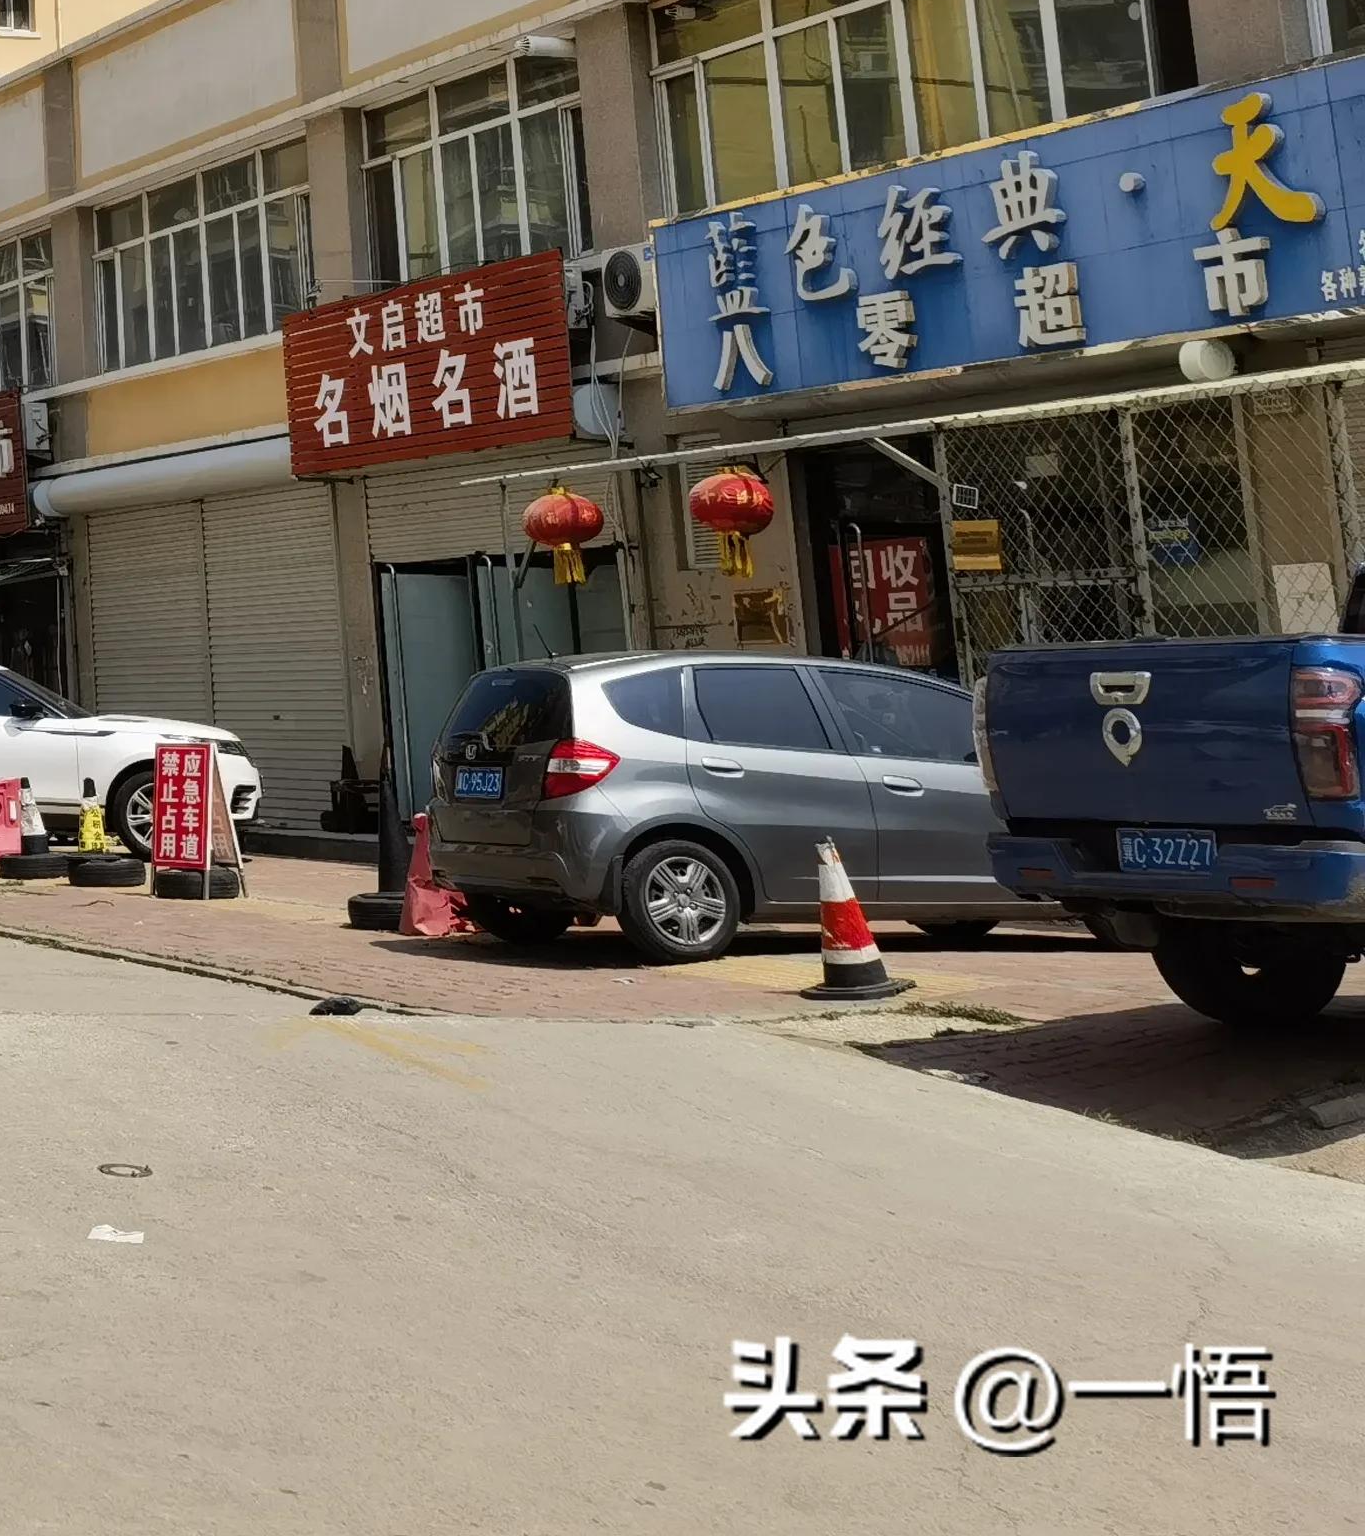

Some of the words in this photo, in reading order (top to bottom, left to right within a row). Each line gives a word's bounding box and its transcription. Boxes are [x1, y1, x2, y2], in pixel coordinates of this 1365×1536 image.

[346, 282, 485, 359] 文启超市
[713, 227, 1270, 391] 八零超市
[314, 336, 539, 448] 名烟名酒
[159, 751, 181, 859] 禁止占用
[180, 751, 202, 860] 应急车道
